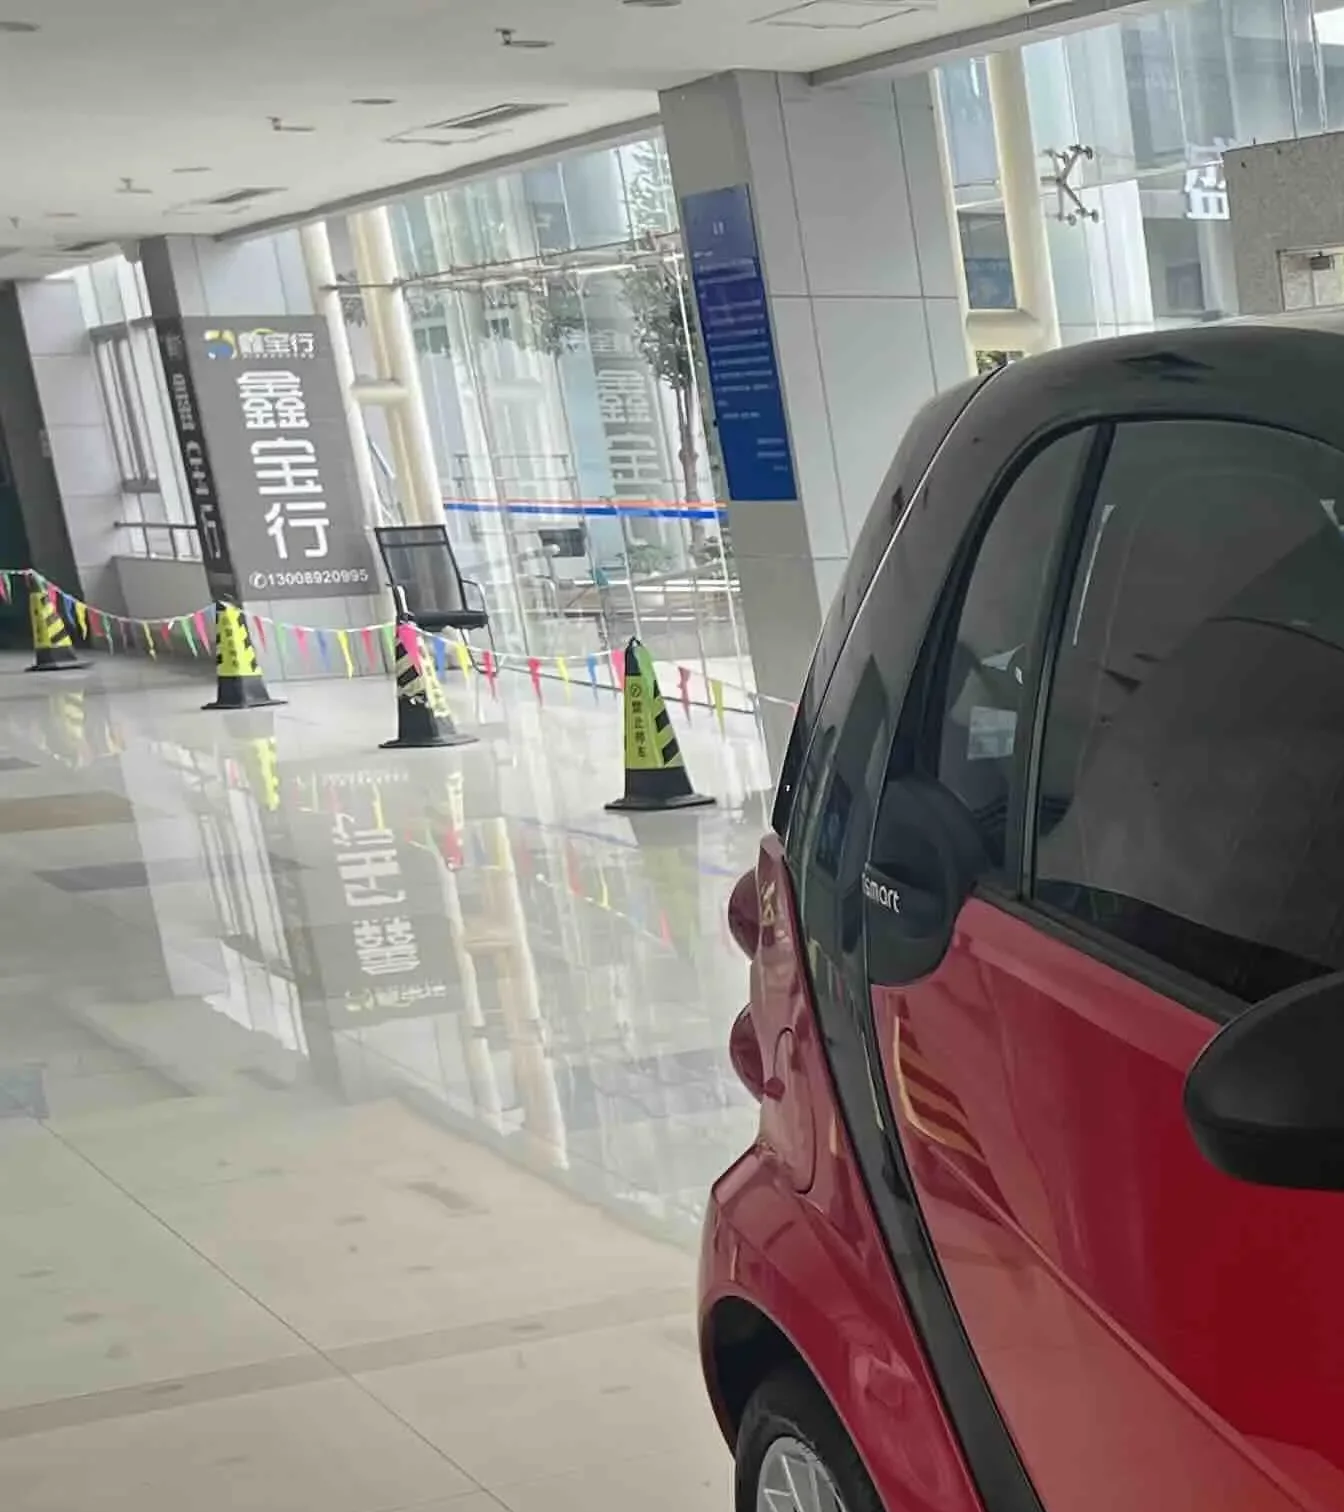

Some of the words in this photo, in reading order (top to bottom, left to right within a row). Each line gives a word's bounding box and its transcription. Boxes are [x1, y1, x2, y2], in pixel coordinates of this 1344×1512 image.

[235, 369, 330, 559] 鑫宝行
[864, 876, 901, 913] smart
